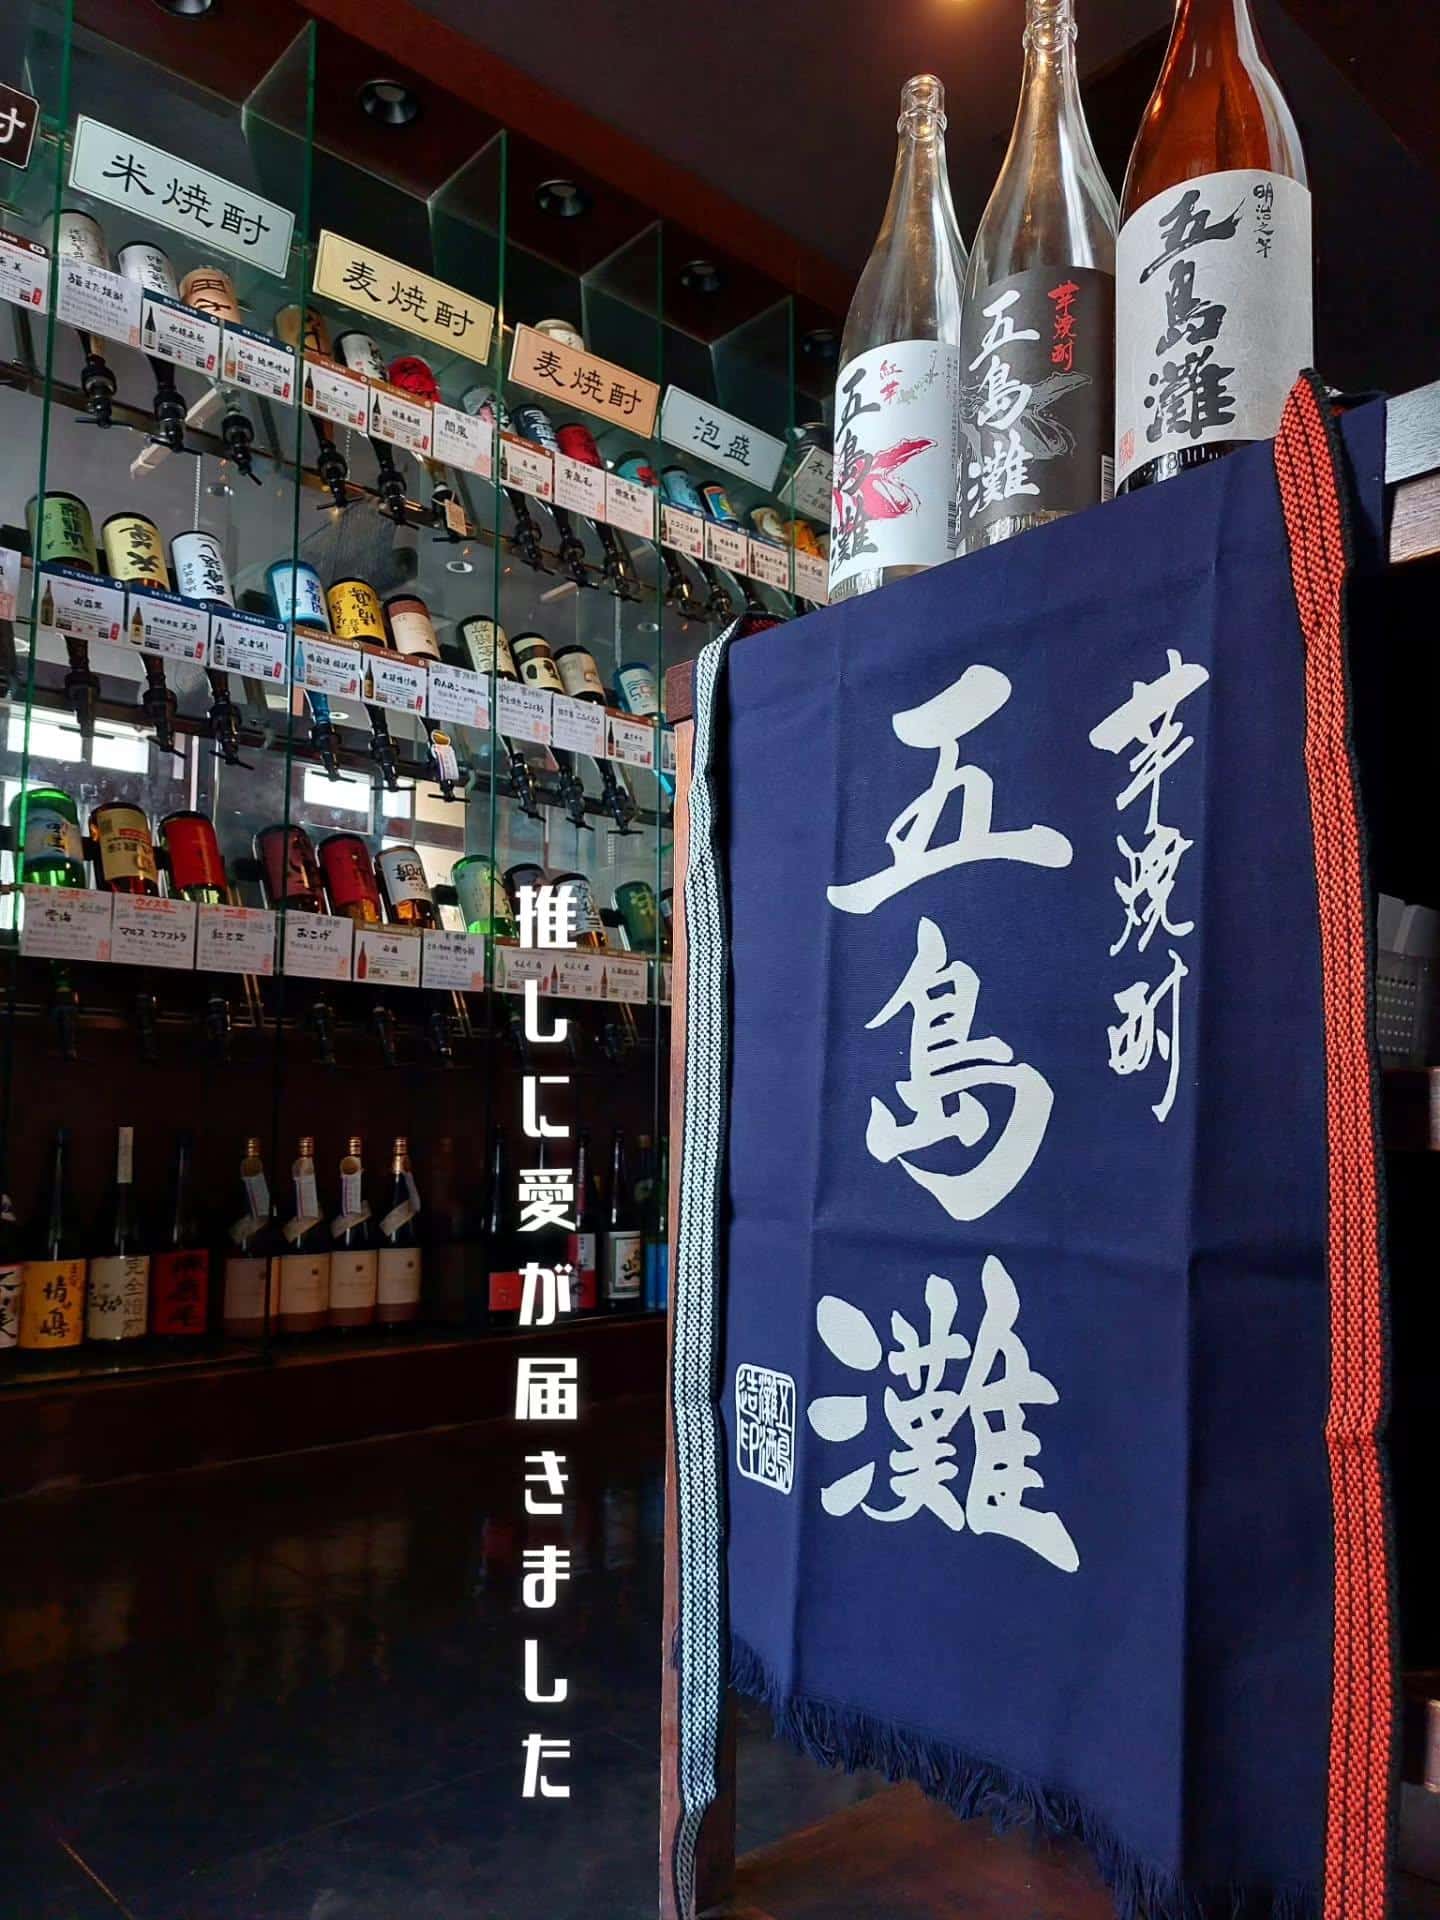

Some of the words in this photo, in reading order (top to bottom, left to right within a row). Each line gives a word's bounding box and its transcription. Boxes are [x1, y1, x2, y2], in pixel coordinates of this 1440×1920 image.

[102, 153, 271, 246] 米焼酎
[342, 260, 475, 337] 麦焼酎
[1140, 190, 1247, 443] 五島灘
[532, 350, 643, 415] 麦焼酎
[967, 290, 1040, 519] 五島灘
[691, 416, 751, 468] 泡盛
[831, 367, 881, 577] 五島灘
[119, 523, 157, 573] 天草
[808, 664, 1079, 1573] 五島灘
